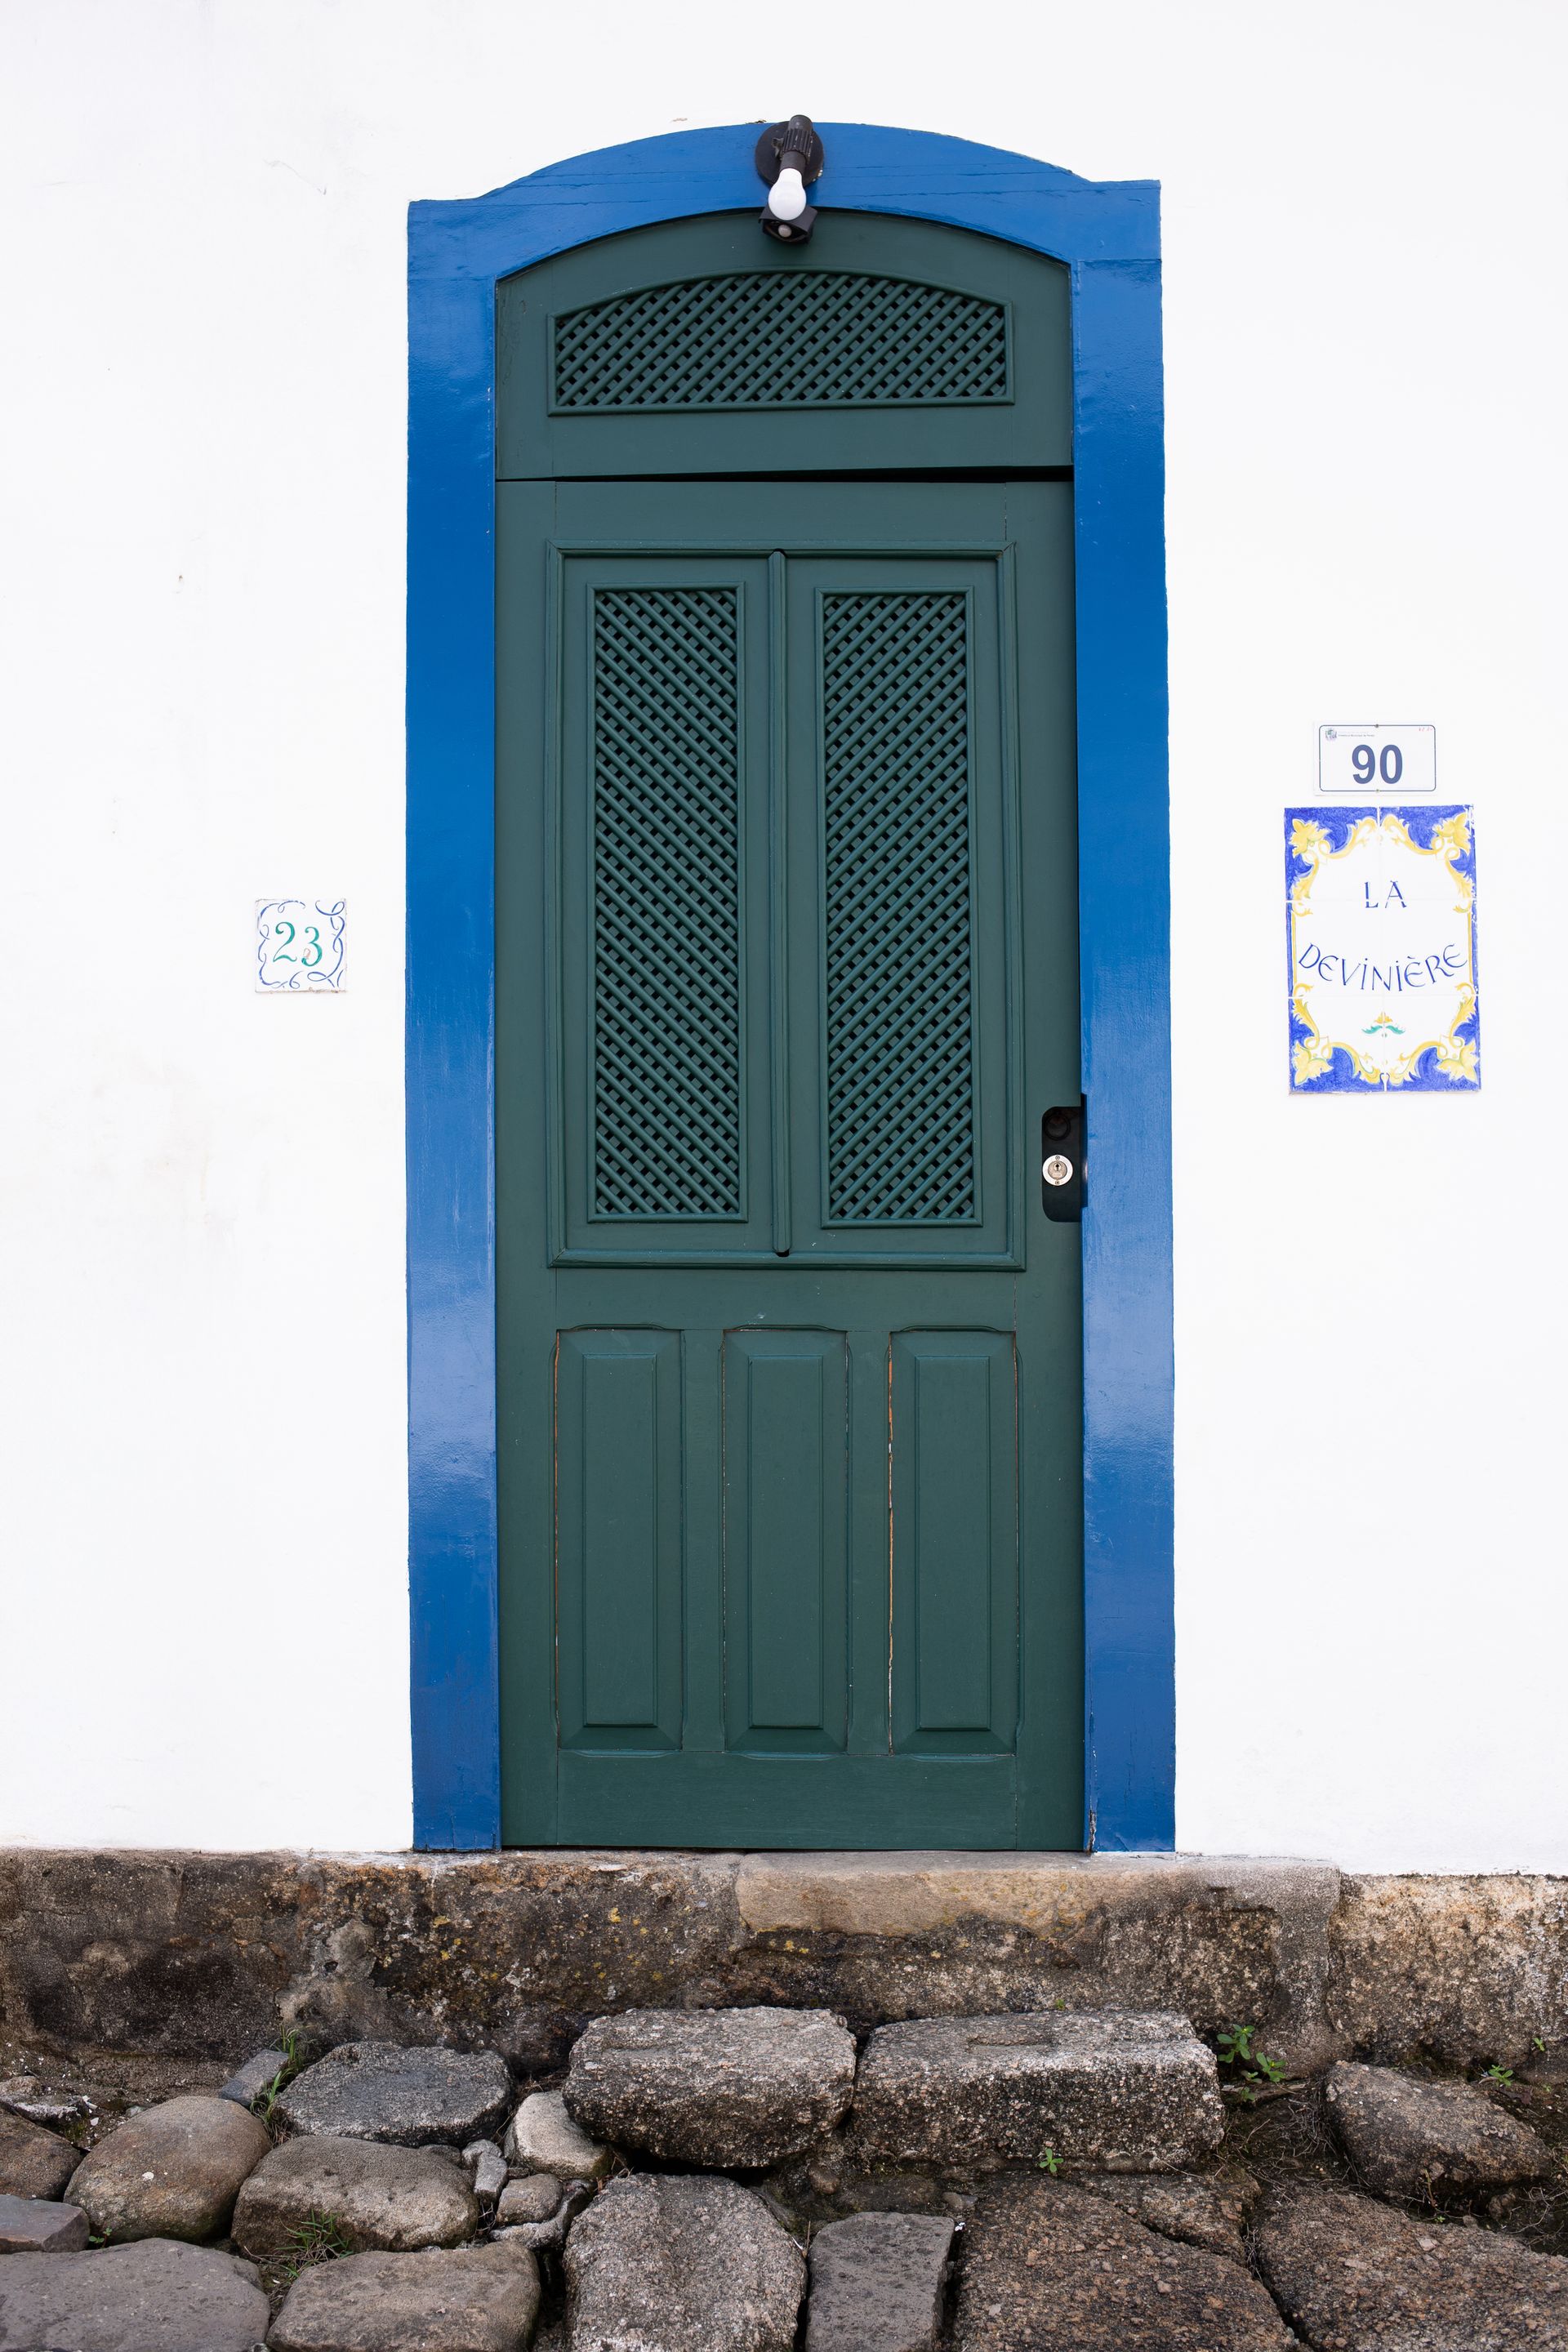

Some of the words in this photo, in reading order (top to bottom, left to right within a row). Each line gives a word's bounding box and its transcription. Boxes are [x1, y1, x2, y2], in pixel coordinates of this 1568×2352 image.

[1352, 744, 1403, 785] 90
[1364, 880, 1407, 909] LA
[273, 921, 323, 967] 23
